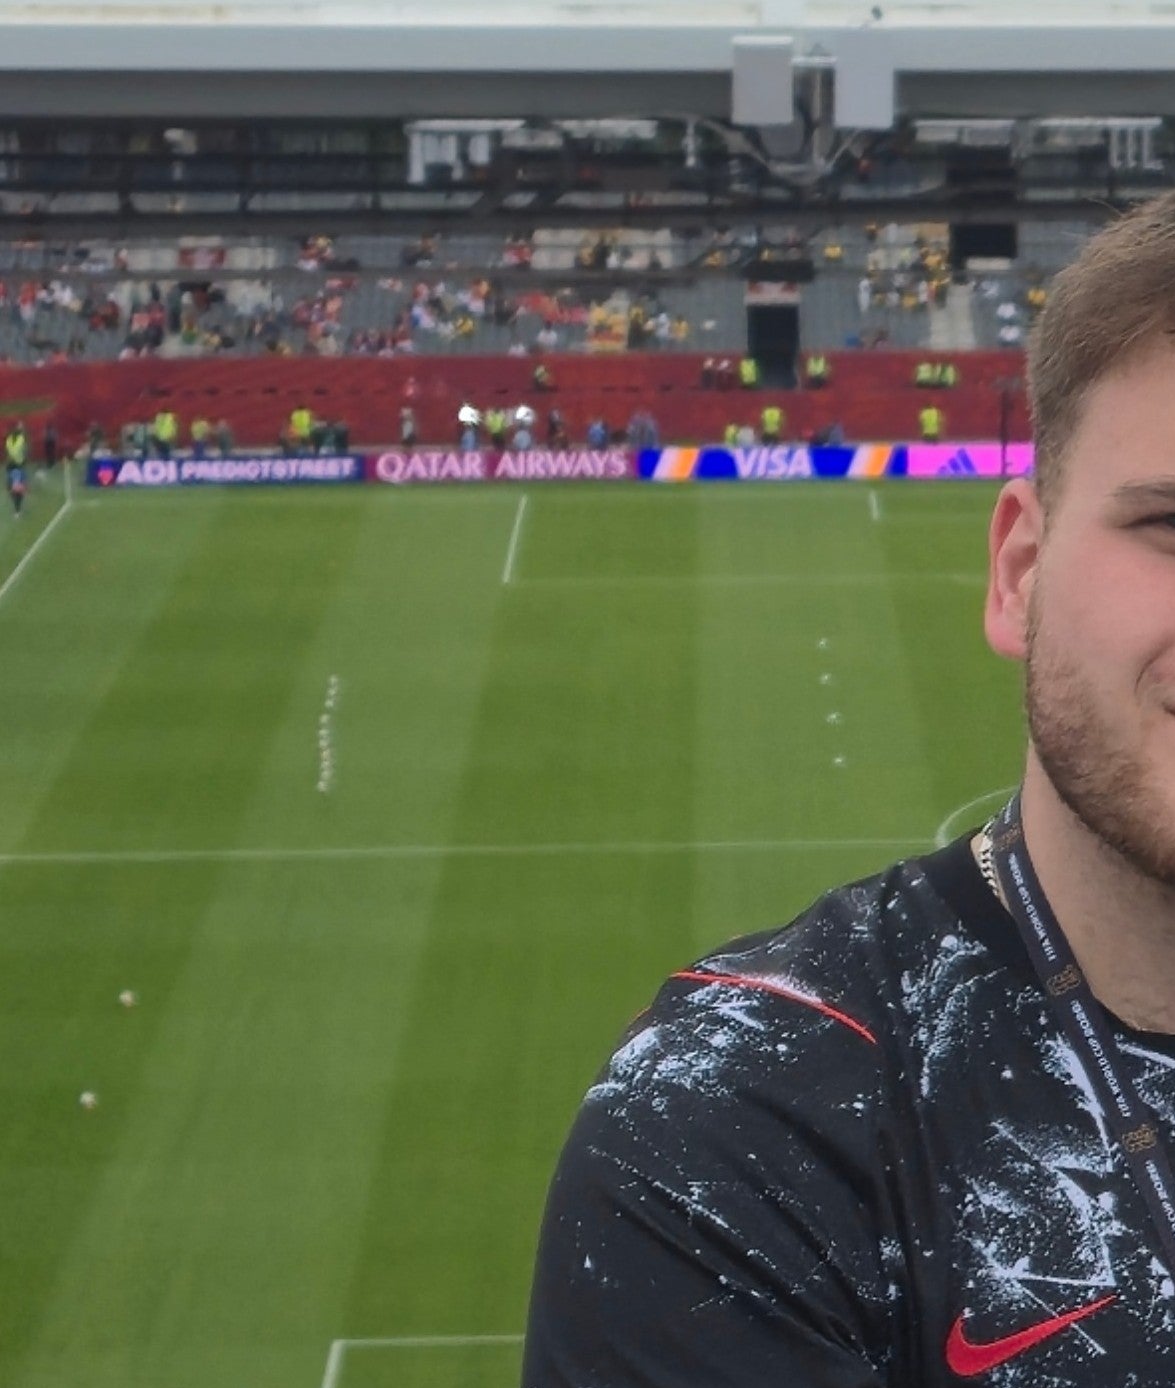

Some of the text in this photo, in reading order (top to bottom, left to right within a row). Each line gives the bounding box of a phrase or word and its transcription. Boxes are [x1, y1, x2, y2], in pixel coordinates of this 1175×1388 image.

[116, 458, 354, 483] ADI PREDICTSTREET
[376, 450, 627, 483] QATAR AIRWAYS
[734, 447, 812, 478] VISA
